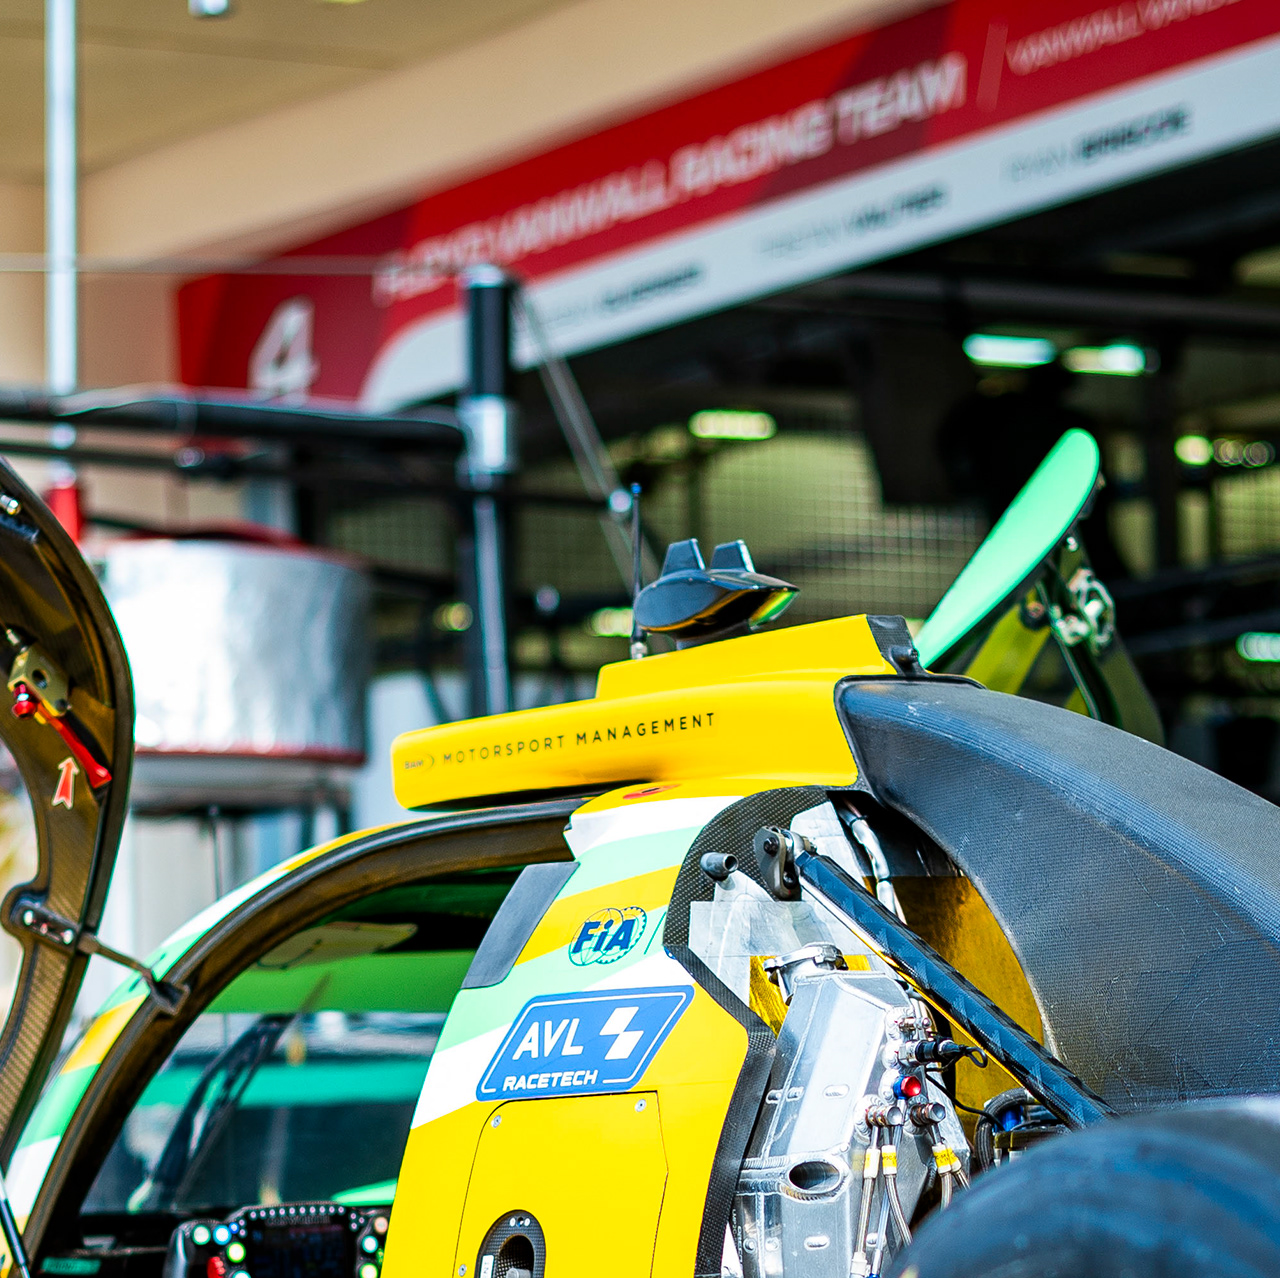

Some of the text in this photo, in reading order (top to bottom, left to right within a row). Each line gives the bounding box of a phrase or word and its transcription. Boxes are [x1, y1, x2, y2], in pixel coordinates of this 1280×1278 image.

[247, 294, 320, 408] 4
[443, 735, 564, 765] MOTORSPORT
[576, 712, 715, 747] MANAGEMENT
[511, 1018, 584, 1060] AVL
[502, 1069, 598, 1091] RACETECH
